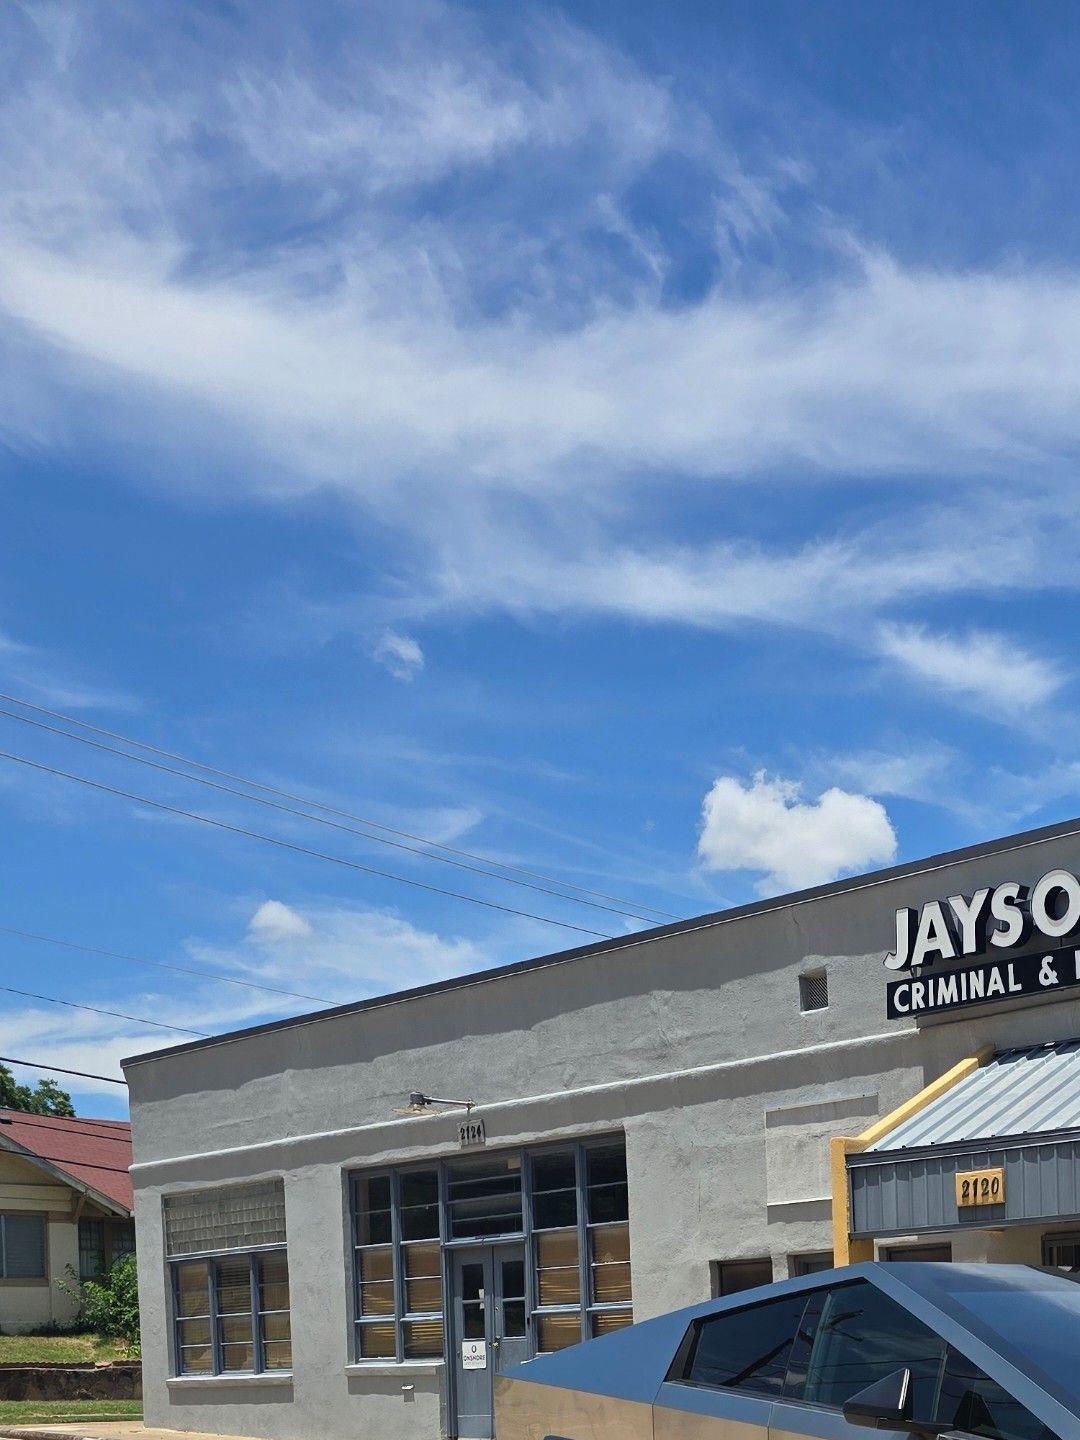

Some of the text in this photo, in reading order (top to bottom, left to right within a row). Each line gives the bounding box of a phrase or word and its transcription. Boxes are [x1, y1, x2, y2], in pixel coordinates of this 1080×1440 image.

[893, 964, 1022, 1014] CRIMINAL
[1038, 956, 1059, 986] &
[460, 1124, 482, 1140] 2124
[961, 1176, 999, 1200] 2120
